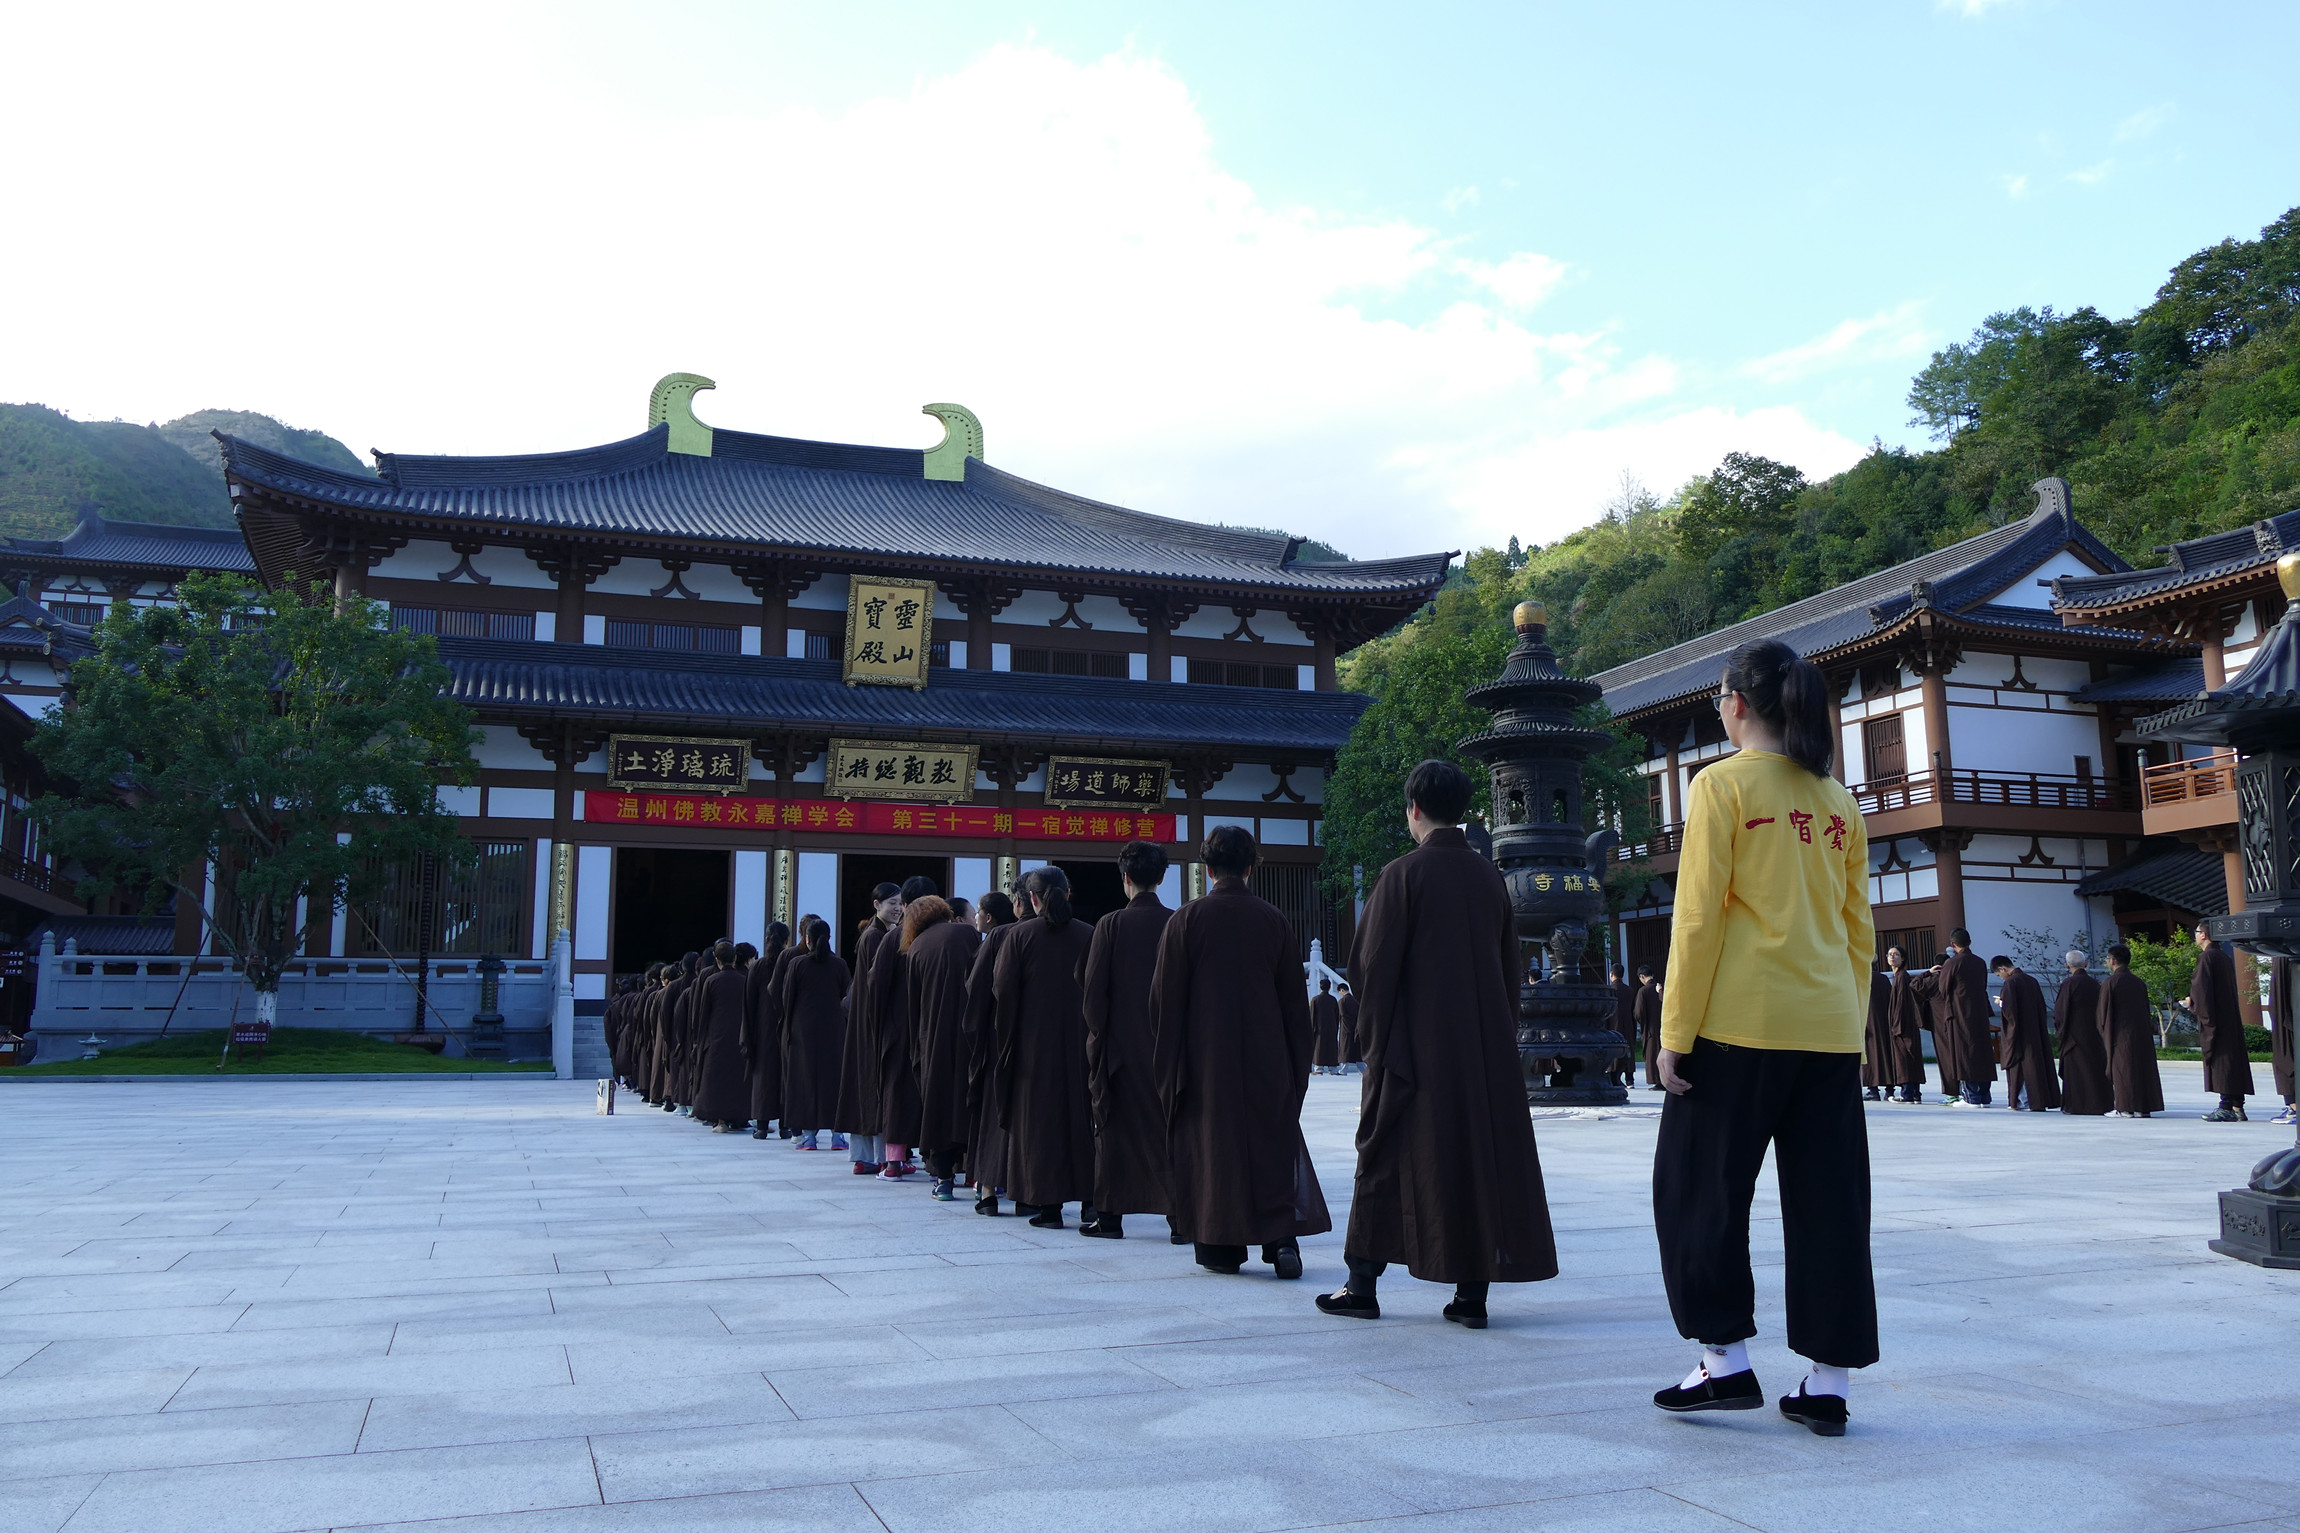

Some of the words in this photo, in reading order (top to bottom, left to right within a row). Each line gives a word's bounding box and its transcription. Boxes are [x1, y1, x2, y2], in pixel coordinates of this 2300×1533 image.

[616, 796, 855, 828] 温州佛教永嘉禅学会
[891, 809, 1156, 838] 第三十一期一宿觉禅修营
